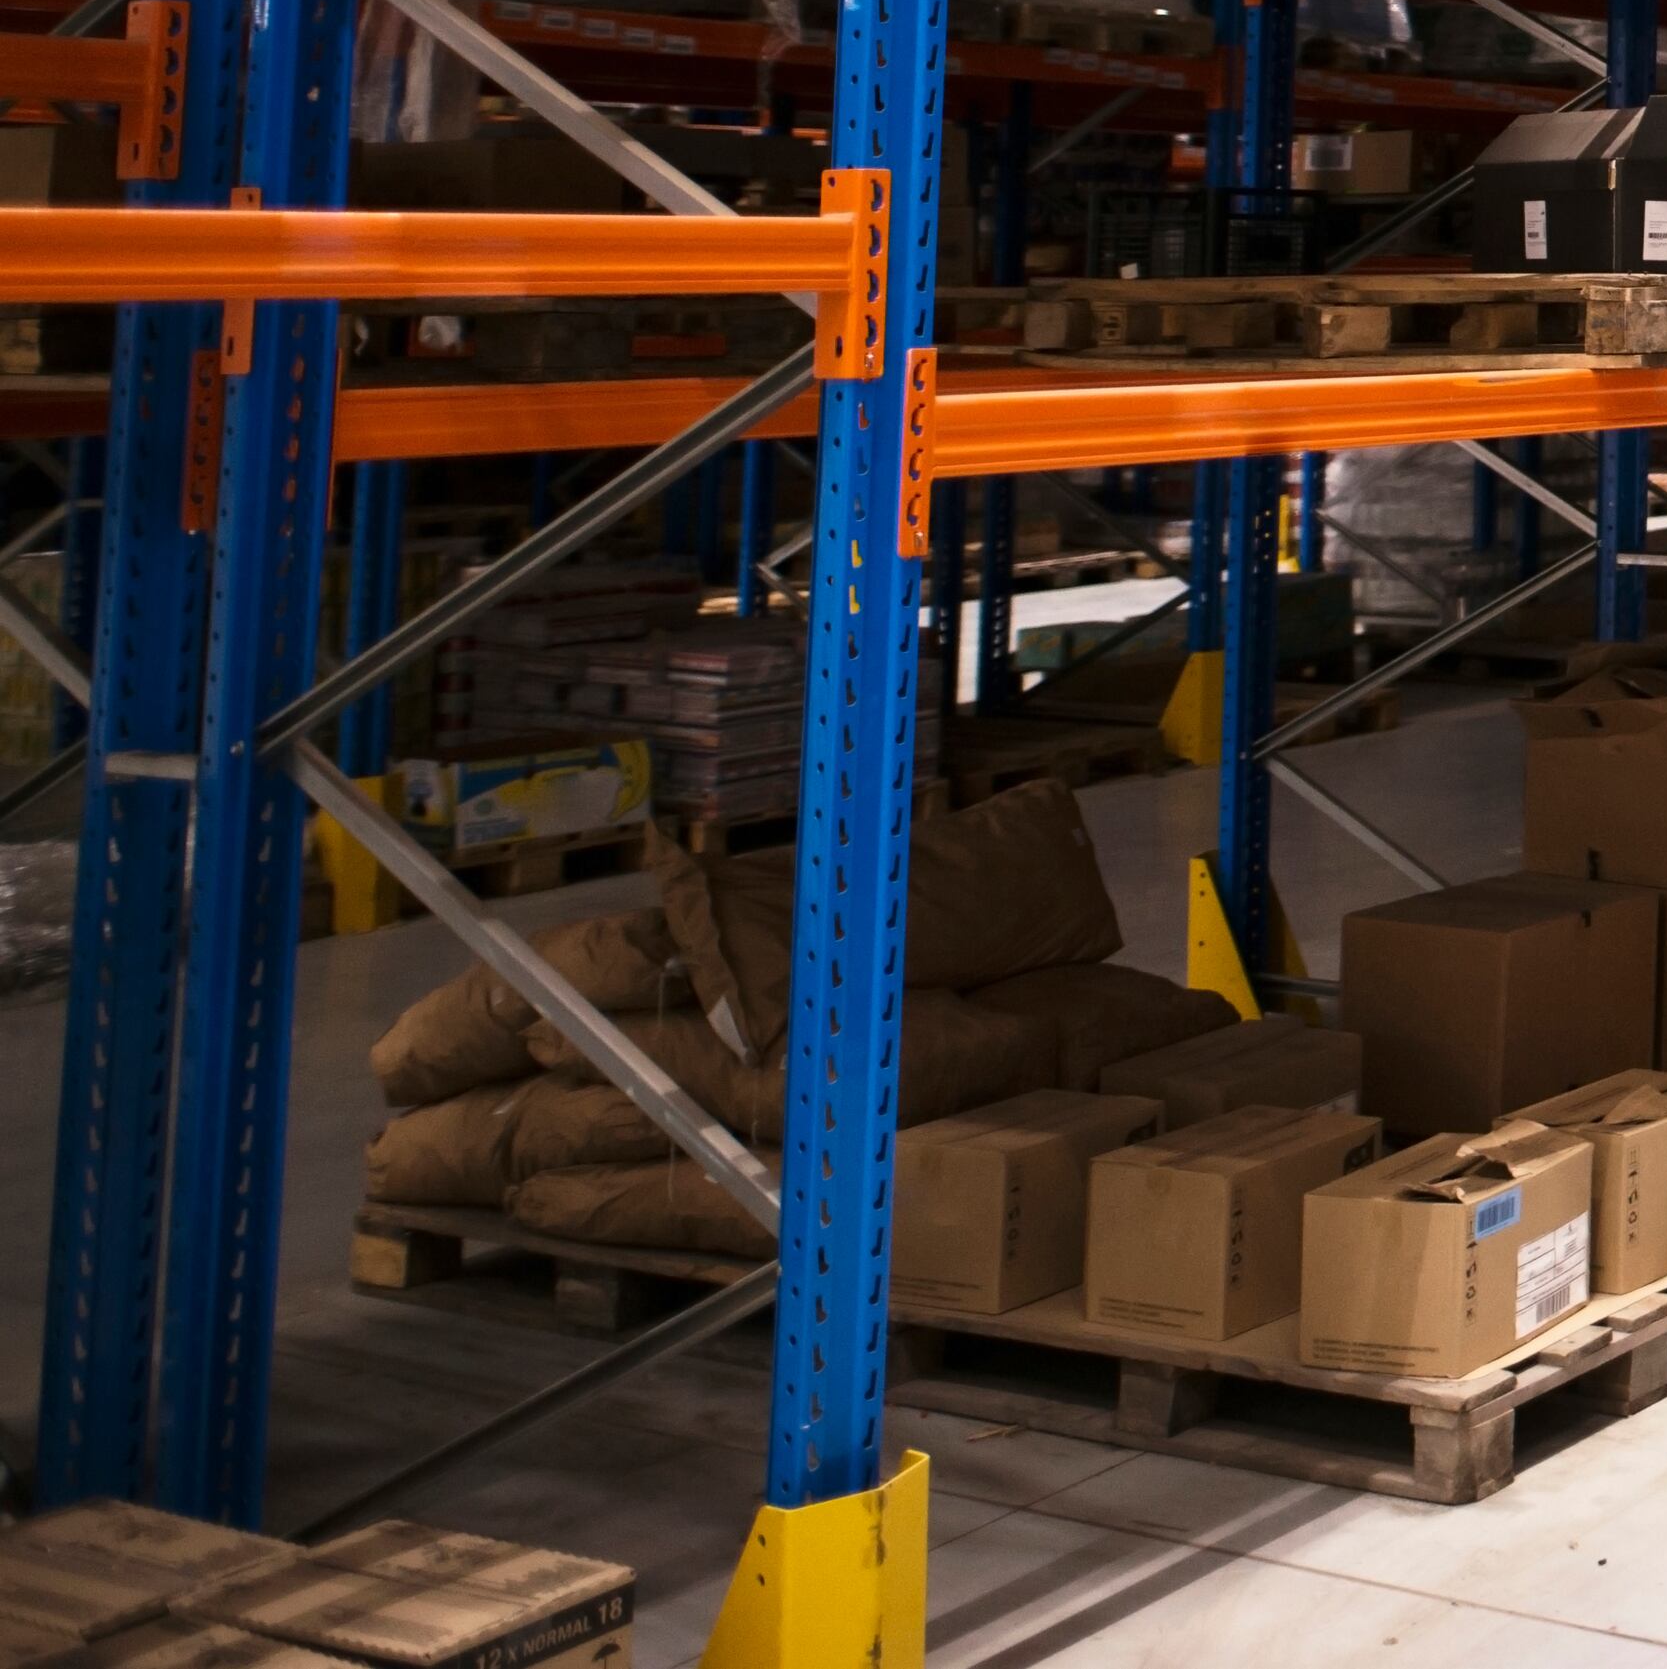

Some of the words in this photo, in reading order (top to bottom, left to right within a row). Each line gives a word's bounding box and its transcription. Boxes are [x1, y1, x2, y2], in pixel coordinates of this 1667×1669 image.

[476, 1648, 501, 1669] 12
[523, 1616, 592, 1657] NORMAL
[598, 1597, 623, 1624] 18
